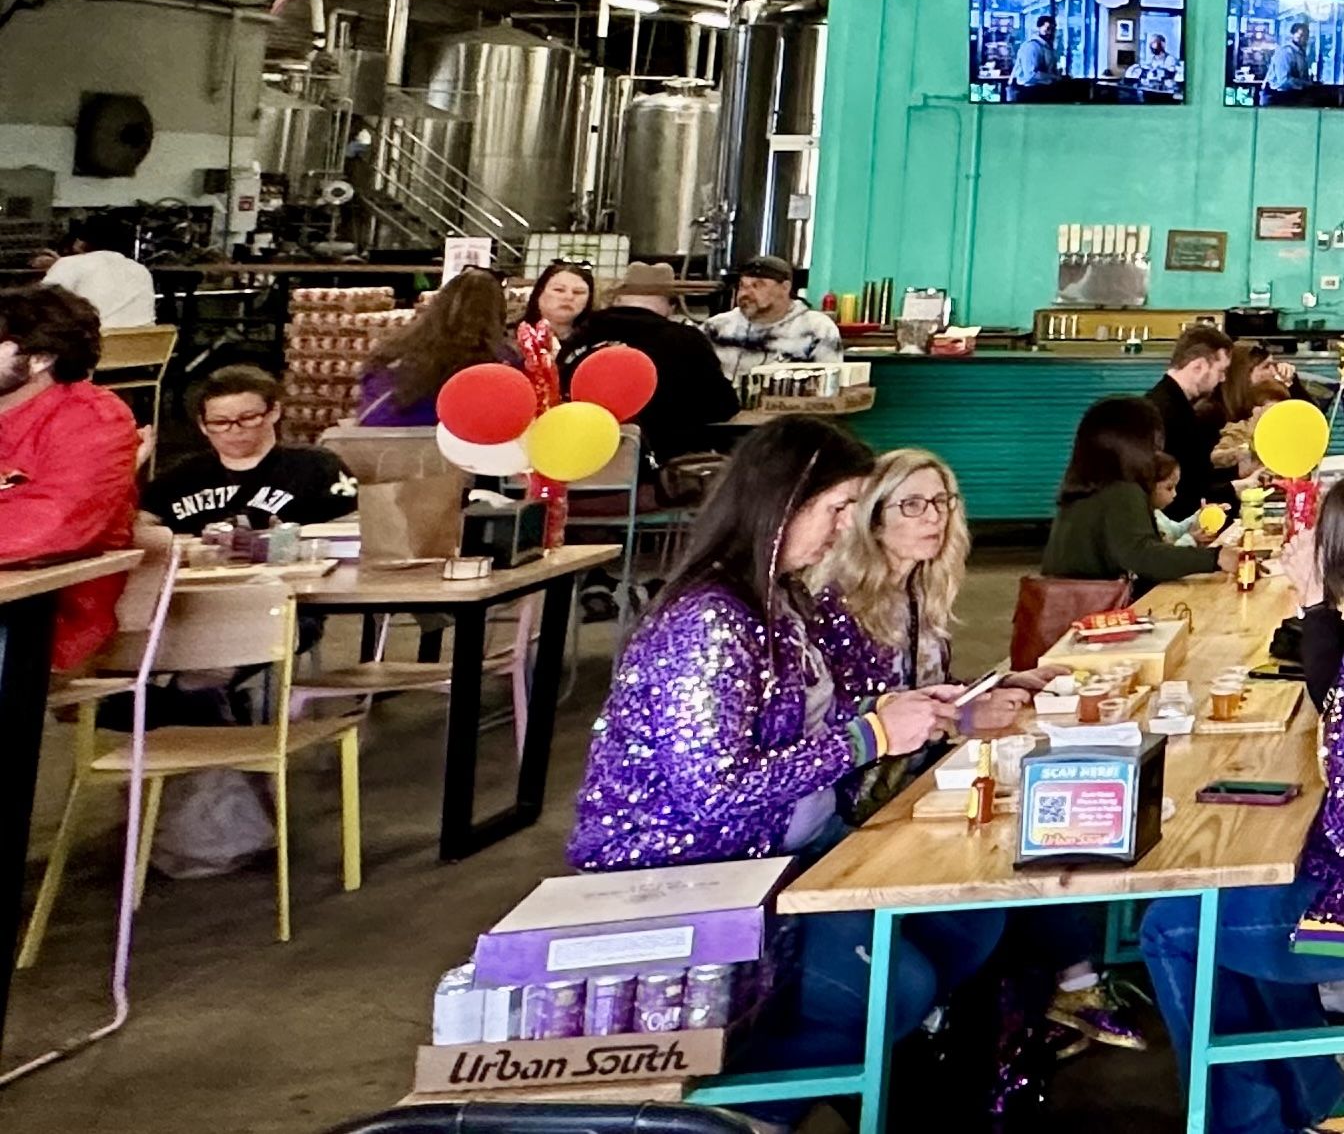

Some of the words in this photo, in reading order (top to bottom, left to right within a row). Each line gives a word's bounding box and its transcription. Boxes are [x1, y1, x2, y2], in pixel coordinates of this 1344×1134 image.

[1040, 766, 1077, 780] SCAN
[447, 1048, 568, 1085] Urban
[571, 1039, 689, 1078] South
